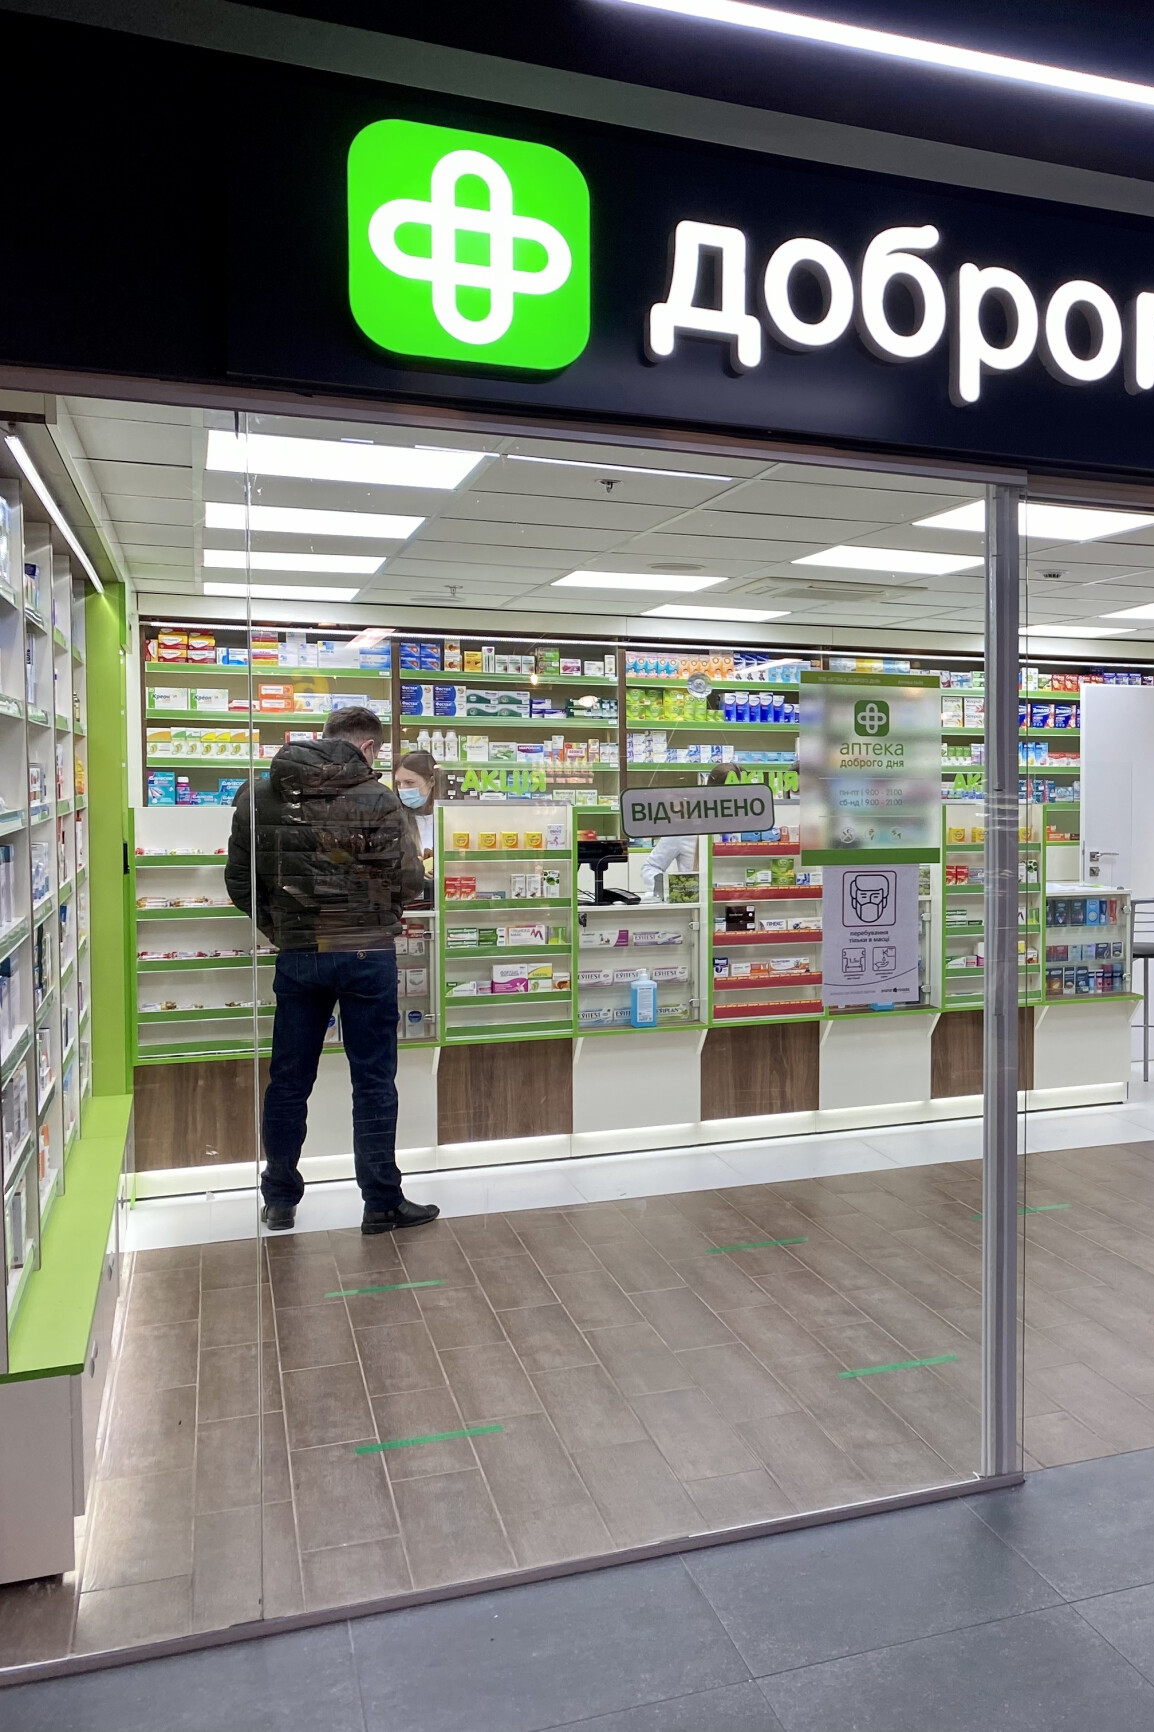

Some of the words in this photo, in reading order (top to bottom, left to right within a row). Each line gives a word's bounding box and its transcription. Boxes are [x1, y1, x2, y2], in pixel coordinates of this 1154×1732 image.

[839, 742, 904, 756] аптека
[840, 758, 883, 769] доброго
[885, 759, 904, 768] дня
[460, 769, 547, 796] АКЦІЯ
[631, 797, 766, 825] ВІДЧИНЕНО
